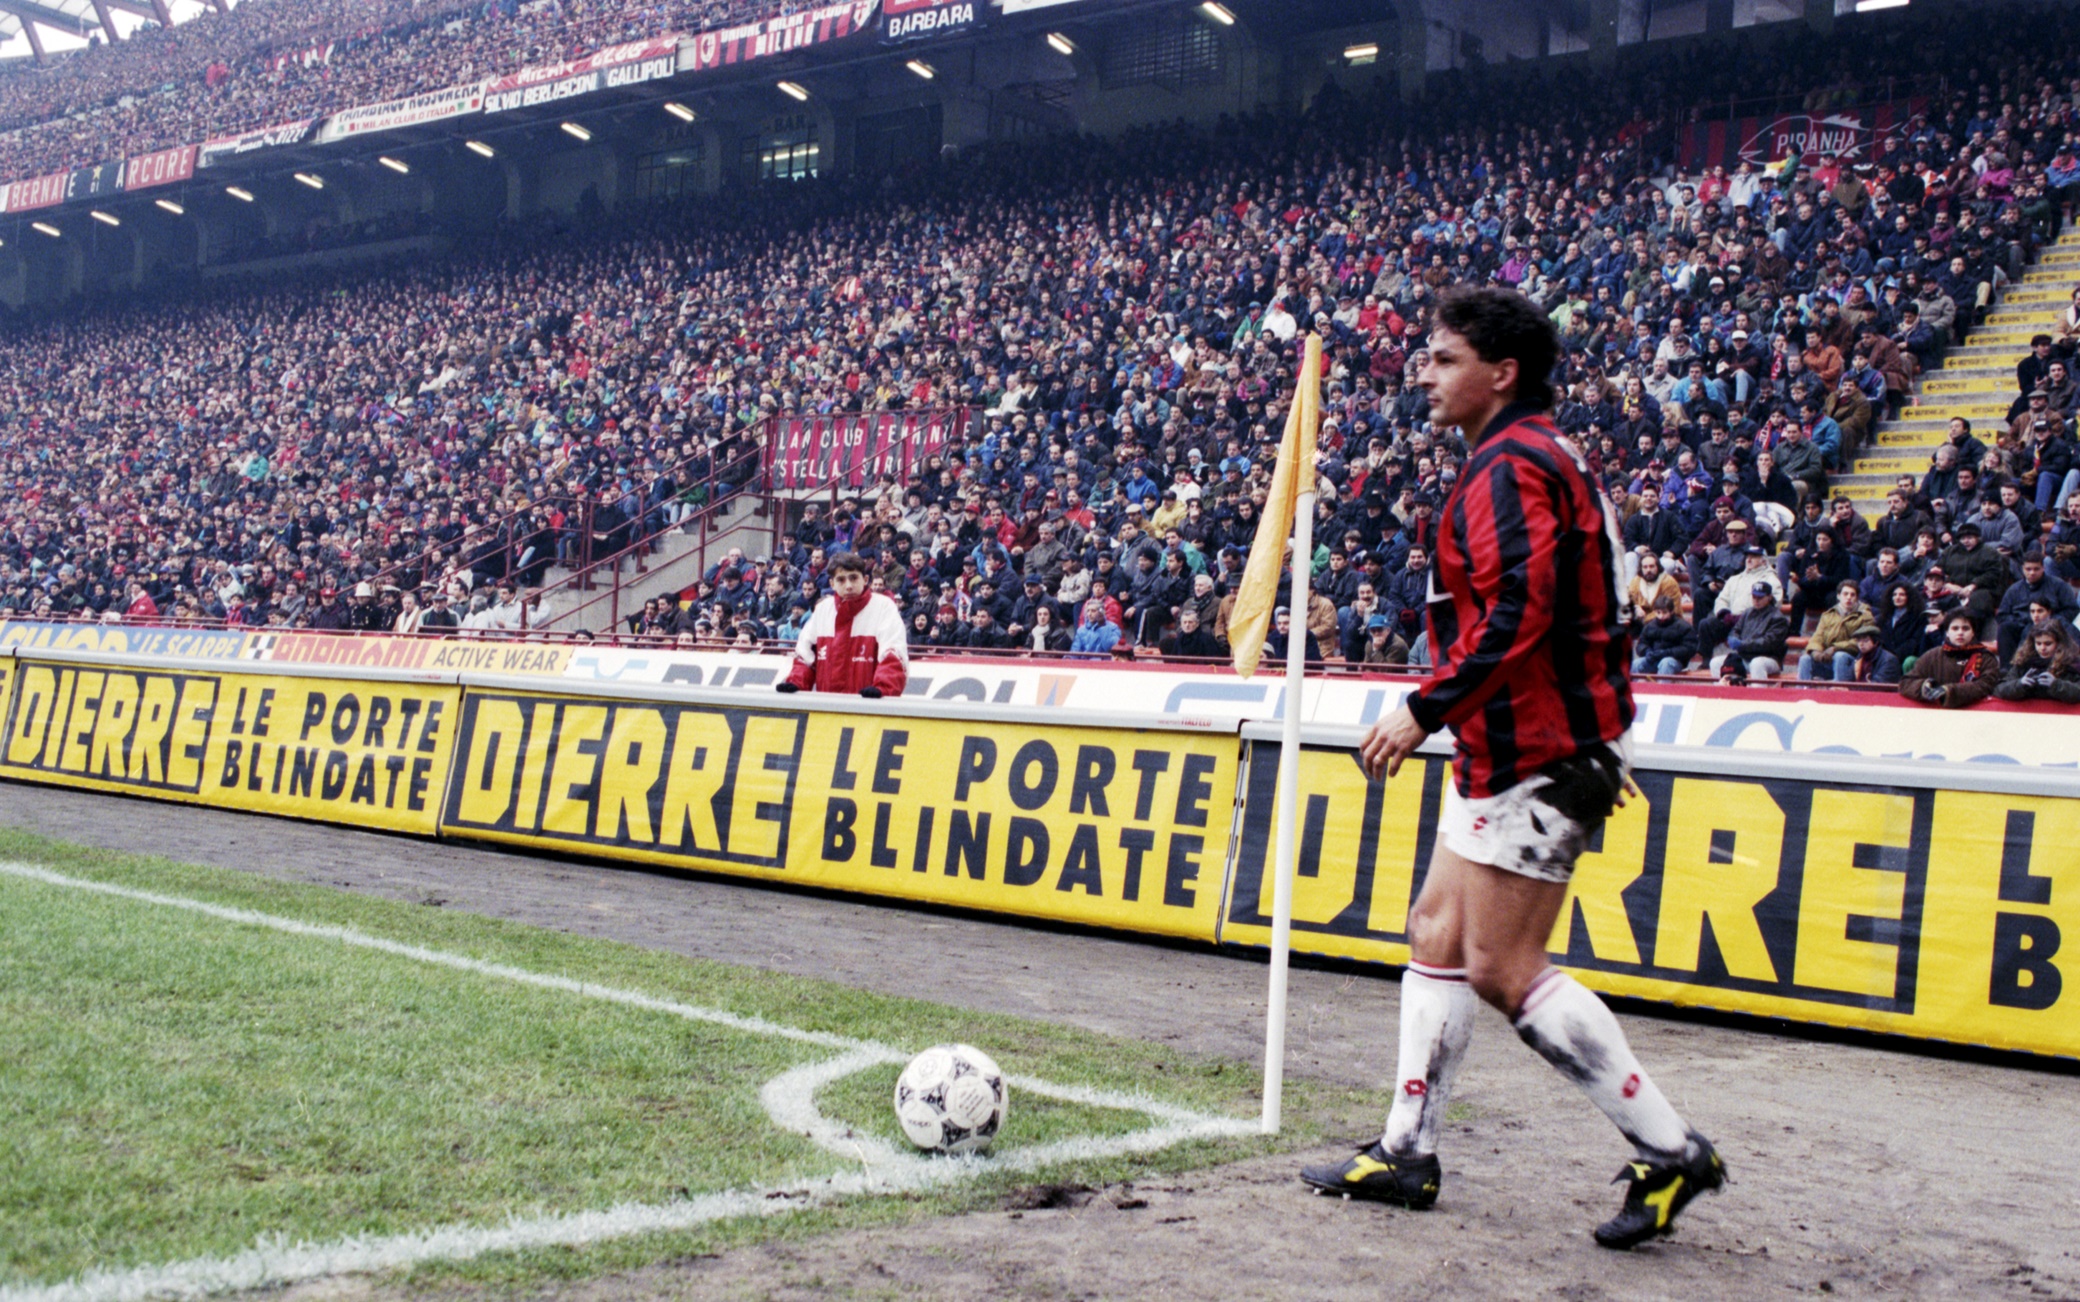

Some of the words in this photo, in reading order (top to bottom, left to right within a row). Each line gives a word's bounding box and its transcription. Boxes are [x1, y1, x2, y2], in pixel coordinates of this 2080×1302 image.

[755, 22, 814, 55] MILANO
[889, 4, 974, 38] BARBARA
[485, 90, 521, 115] SILVIO
[523, 72, 599, 108] BERLUSCONI
[607, 56, 675, 87] GALLIPOLI
[362, 118, 391, 130] MILAN
[393, 114, 416, 125] CLUB
[12, 172, 78, 208] BERNATE
[115, 149, 191, 189] ARCORE
[820, 427, 863, 448] CLUB
[162, 635, 239, 659] SCARPE
[432, 646, 498, 668] ACTIVE
[503, 649, 560, 671] WEAR
[7, 667, 215, 787] DIERRE
[231, 687, 276, 736] LE
[299, 692, 445, 753] PORTE
[220, 740, 433, 811] BLINDATE
[458, 699, 799, 858] DIERRE
[830, 727, 910, 794] LE
[954, 735, 1218, 828] PORTE
[821, 797, 1206, 908] BLINDATE
